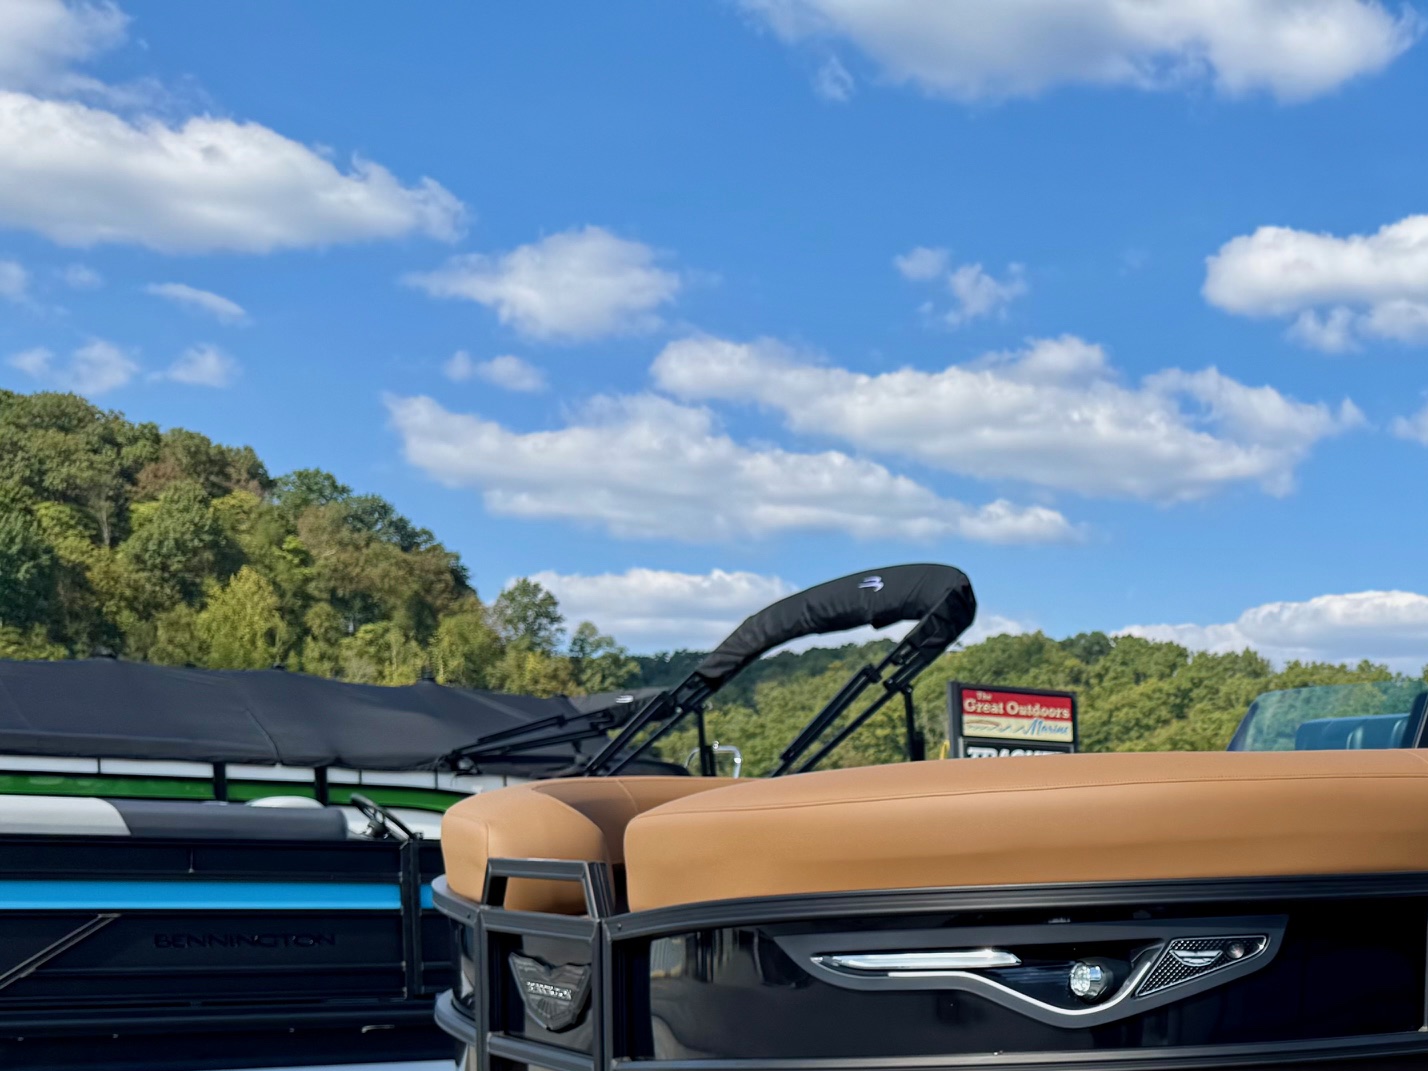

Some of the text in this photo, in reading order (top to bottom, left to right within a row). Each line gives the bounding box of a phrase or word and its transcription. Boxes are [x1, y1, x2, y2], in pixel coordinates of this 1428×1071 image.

[976, 690, 992, 701] The
[963, 698, 1070, 719] Great Outdoors
[1025, 718, 1069, 736] Marine
[154, 932, 336, 949] BENNINGTON
